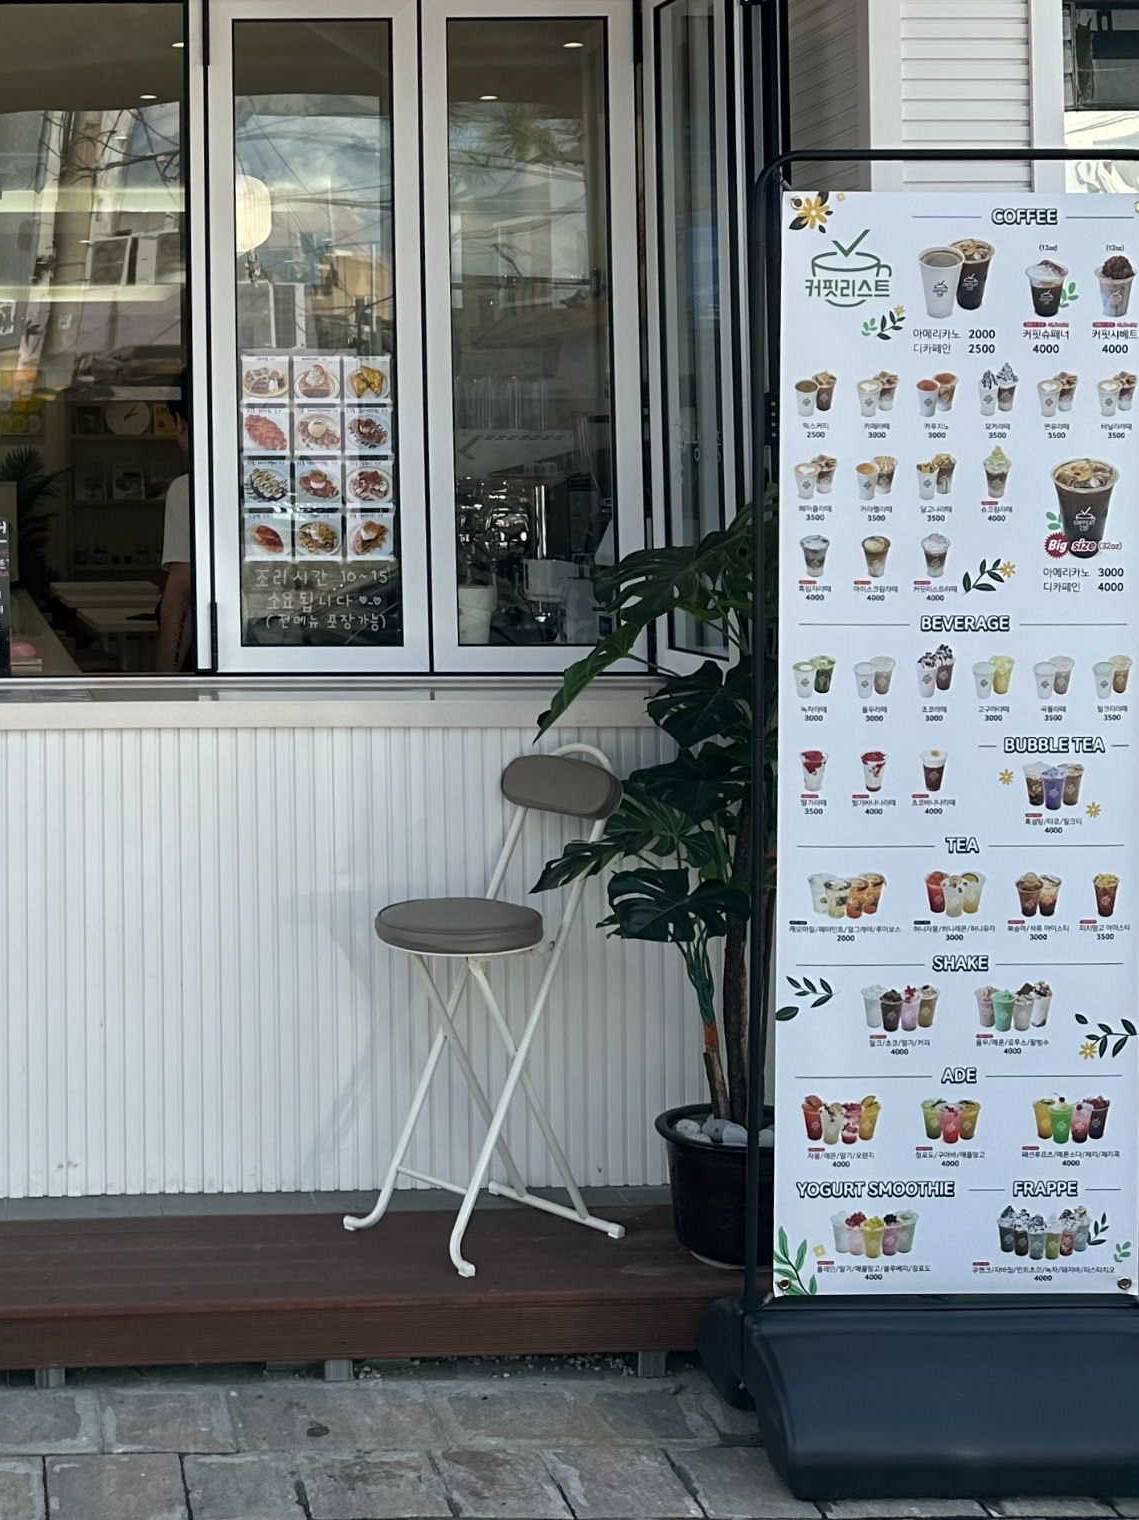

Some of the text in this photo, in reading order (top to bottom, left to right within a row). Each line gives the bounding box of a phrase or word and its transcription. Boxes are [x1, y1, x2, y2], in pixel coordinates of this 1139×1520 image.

[990, 207, 1059, 226] COFFEE
[805, 278, 892, 298] 커핏리스트
[912, 328, 996, 340] 아메리카노 2000
[1022, 329, 1070, 340] 커핏슈페너
[1091, 329, 1138, 340] 커핏샤베트
[913, 343, 996, 355] 디카페인 2500
[1032, 343, 1060, 354] 4000
[1101, 343, 1129, 354] 4000
[806, 431, 826, 439] 2500
[867, 431, 887, 439] 3000
[927, 431, 947, 439] 3000
[988, 431, 1007, 439] 3500
[1047, 431, 1067, 439] 3500
[1107, 431, 1126, 439] 3500
[805, 513, 825, 522] 3500
[867, 514, 886, 522] 3500
[927, 514, 946, 522] 3500
[987, 514, 1007, 522] 4000
[1047, 537, 1122, 553] Big size (32oz)
[340, 569, 388, 583] 10~15
[1042, 567, 1125, 579] 아메리카노 3000
[1043, 581, 1124, 593] 디카페인 4000
[805, 593, 825, 602] 4000
[866, 594, 886, 602] 4000
[925, 594, 945, 602] 4000
[266, 591, 354, 613] 소요됩니다
[920, 614, 1011, 633] BEVERAGE
[804, 714, 824, 722] 3000
[865, 714, 884, 722] 3000
[925, 714, 944, 722] 3000
[984, 714, 1003, 722] 3000
[1043, 714, 1063, 722] 3500
[1103, 713, 1122, 722] 3500
[1003, 736, 1106, 754] BUBBLE TEA
[804, 807, 824, 815] 3500
[864, 807, 884, 815] 4000
[924, 807, 943, 815] 4000
[1044, 826, 1063, 834] 4000
[945, 836, 980, 853] TEA
[836, 934, 856, 942] 2000
[945, 933, 964, 941] 3000
[1029, 933, 1048, 941] 3000
[1096, 933, 1115, 941] 3500
[931, 955, 990, 972] SHAKE
[890, 1048, 910, 1056] 4000
[1003, 1047, 1022, 1055] 4000
[940, 1068, 978, 1084] ADE
[831, 1160, 851, 1168] 4000
[940, 1159, 960, 1167] 4000
[1061, 1159, 1081, 1167] 4000
[796, 1181, 955, 1198] YOGURT SMOOTHIE
[1012, 1180, 1079, 1198] FRAPPE
[864, 1273, 883, 1281] 4000
[1033, 1274, 1053, 1282] 4000
